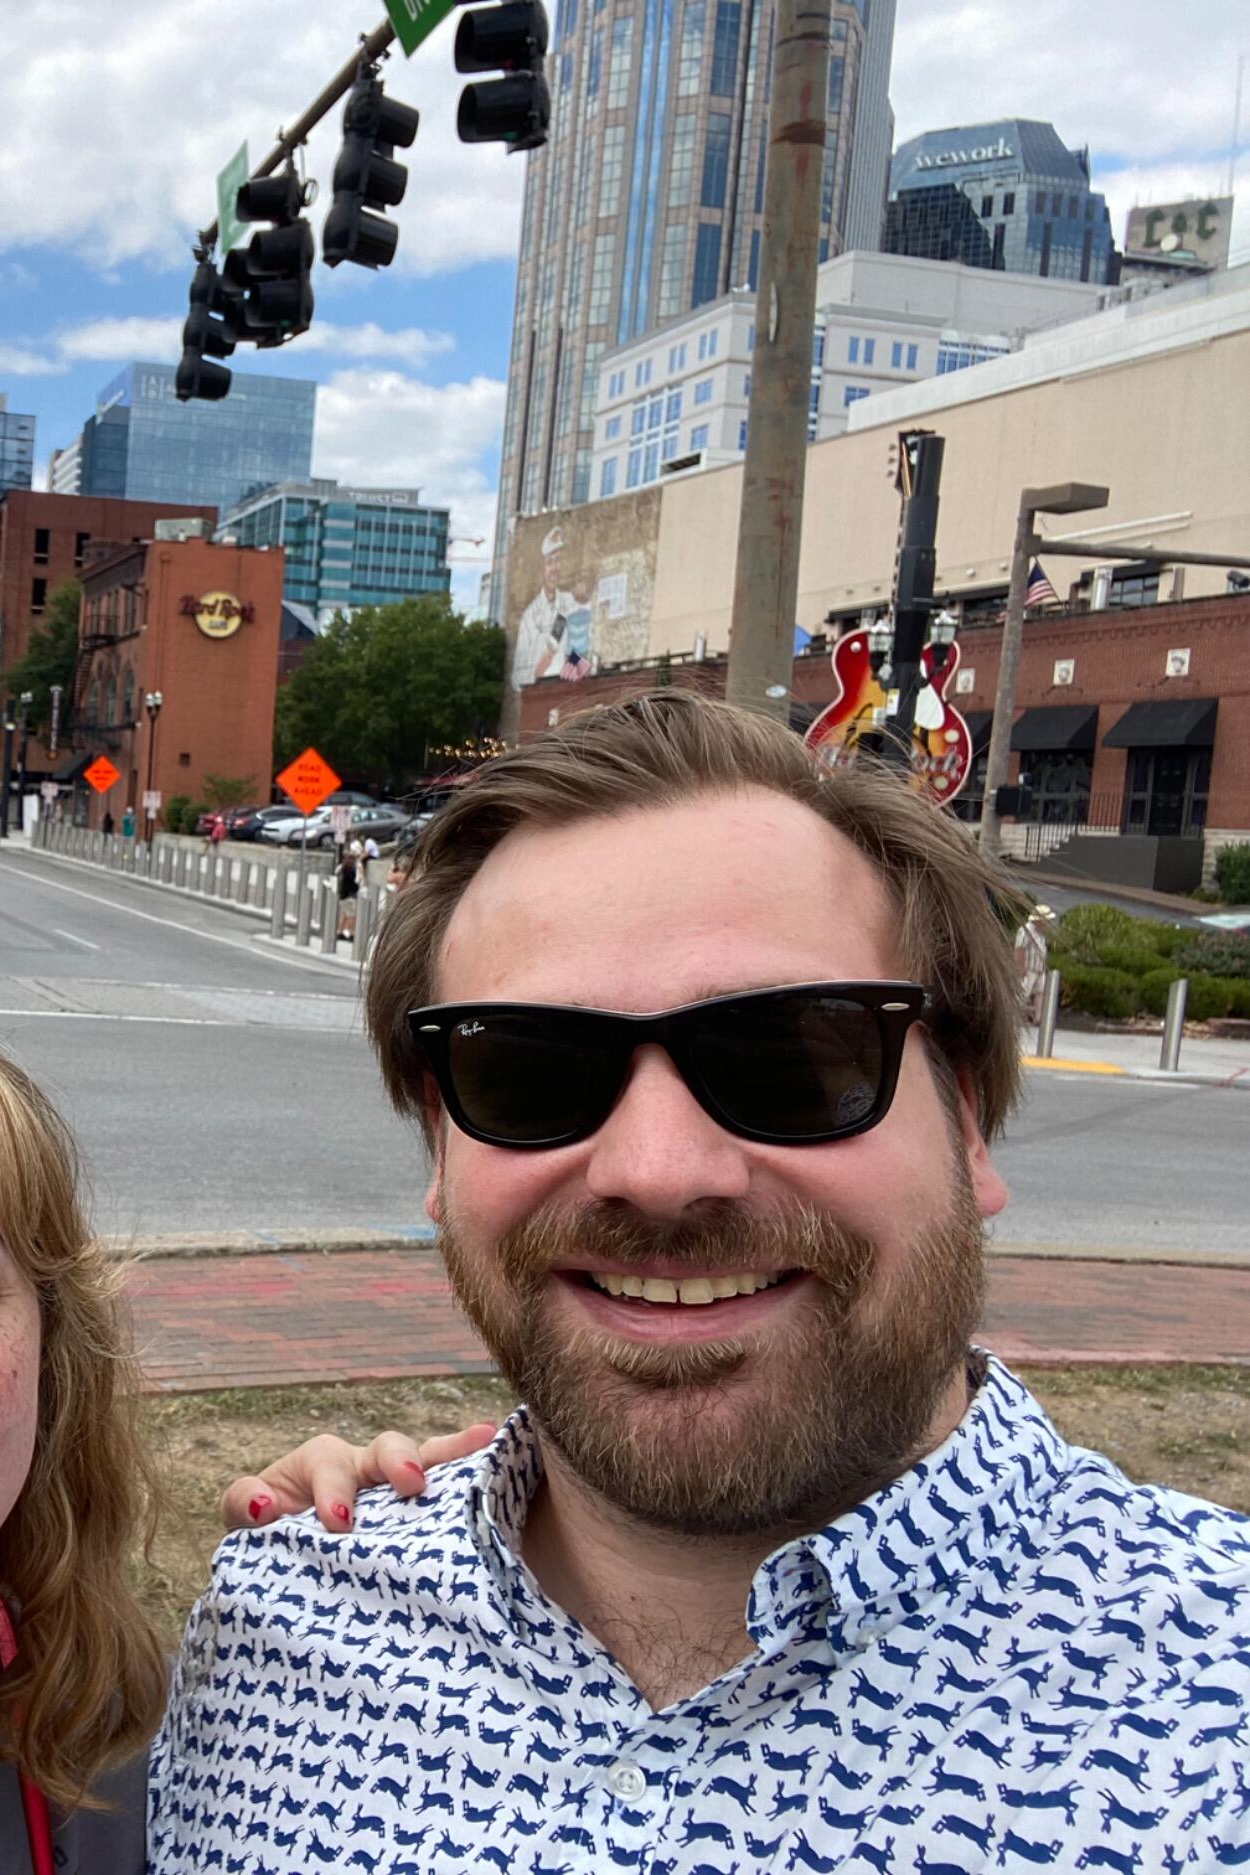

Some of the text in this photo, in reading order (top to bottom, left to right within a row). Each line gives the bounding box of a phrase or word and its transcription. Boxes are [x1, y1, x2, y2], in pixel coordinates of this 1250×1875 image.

[298, 763, 322, 773] ROAD
[297, 775, 320, 783] WORK
[293, 787, 323, 796] AHEAD
